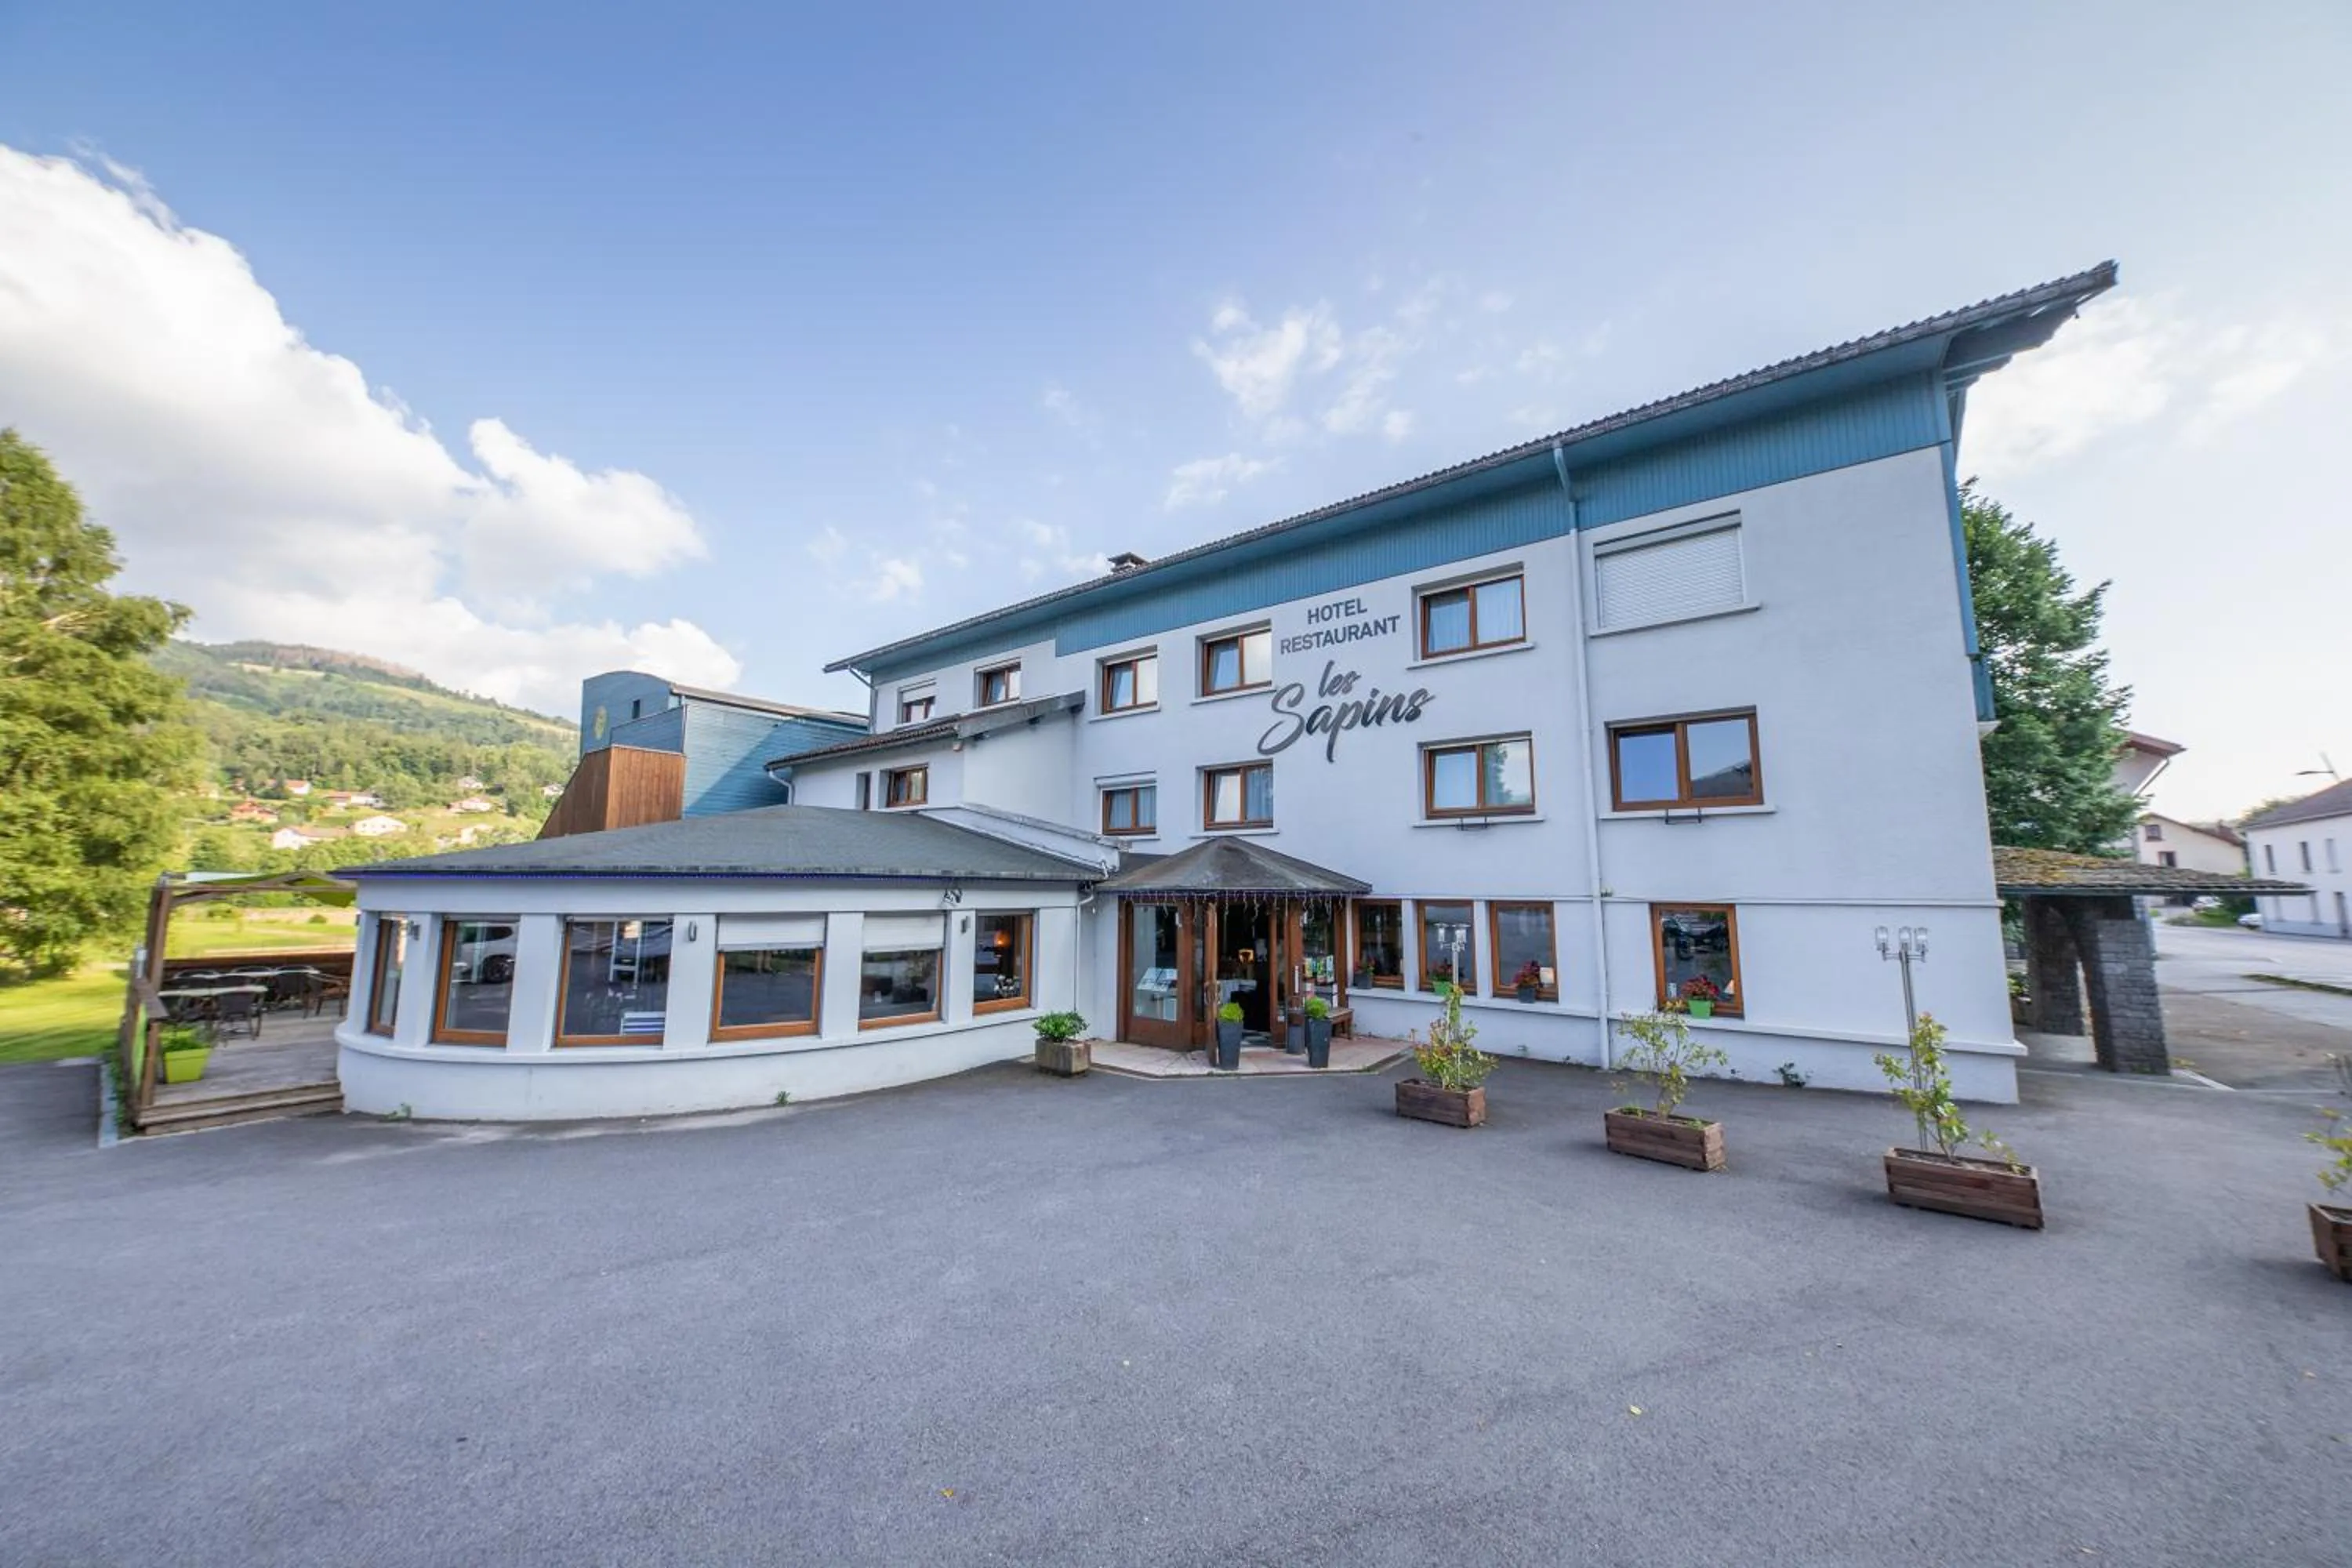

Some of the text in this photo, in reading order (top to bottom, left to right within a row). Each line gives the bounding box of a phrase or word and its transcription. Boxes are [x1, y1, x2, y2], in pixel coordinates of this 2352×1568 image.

[1308, 597, 1367, 624] HOTEL
[1280, 615, 1401, 655] RESTAURANT
[1319, 660, 1362, 698] les
[1257, 683, 1436, 764] Sapins
